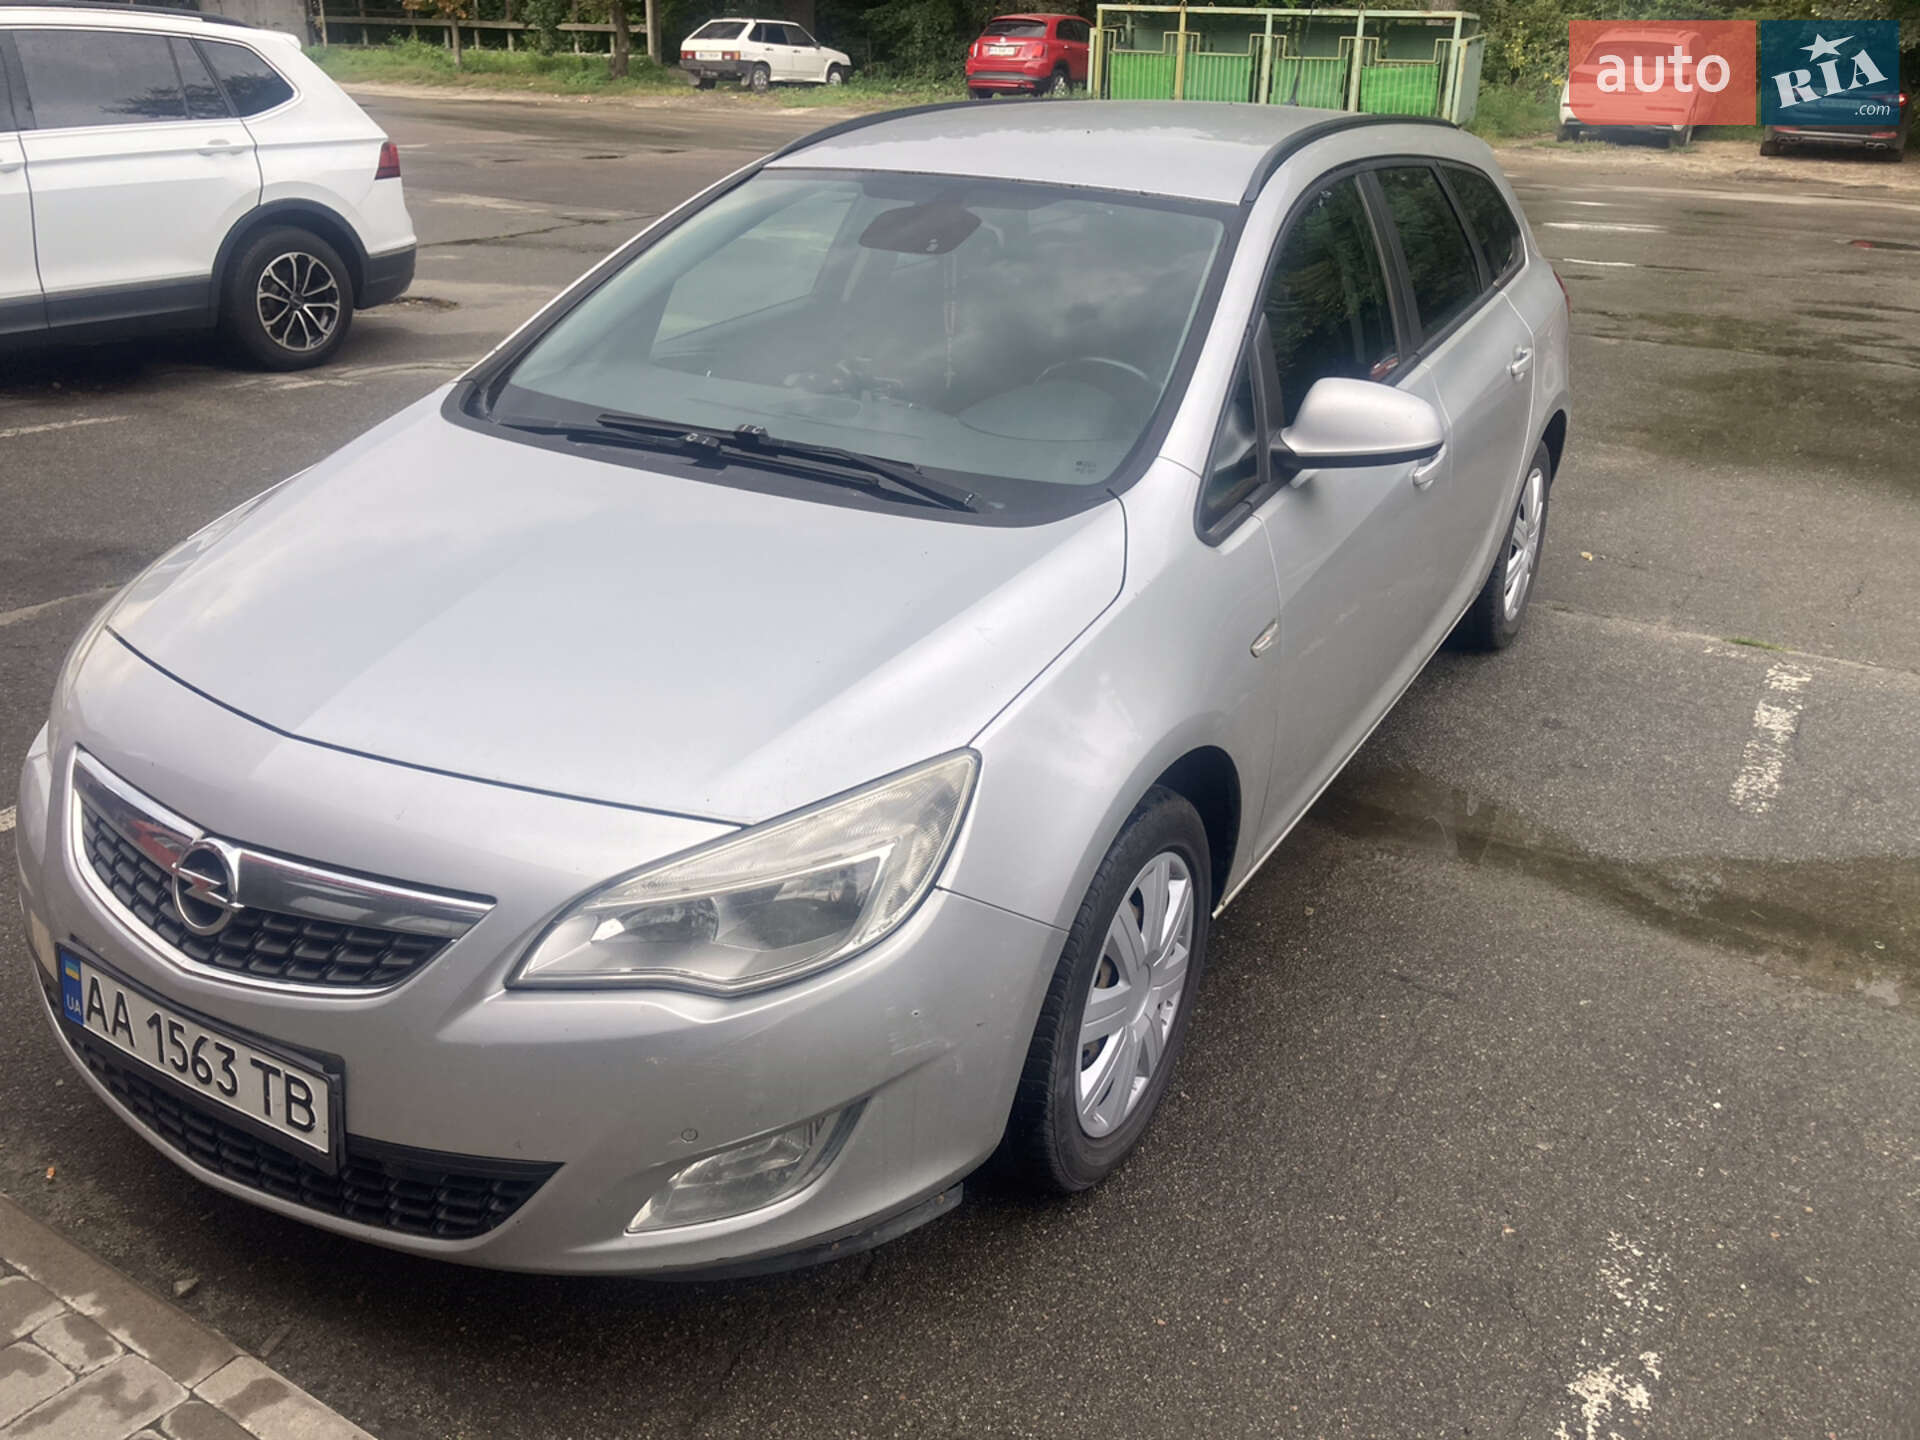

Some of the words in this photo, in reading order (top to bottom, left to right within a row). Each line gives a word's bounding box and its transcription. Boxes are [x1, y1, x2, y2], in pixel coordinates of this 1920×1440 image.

[66, 996, 81, 1016] UA
[86, 976, 135, 1048] AA
[146, 1011, 238, 1098] 1563
[250, 1056, 316, 1132] TB
